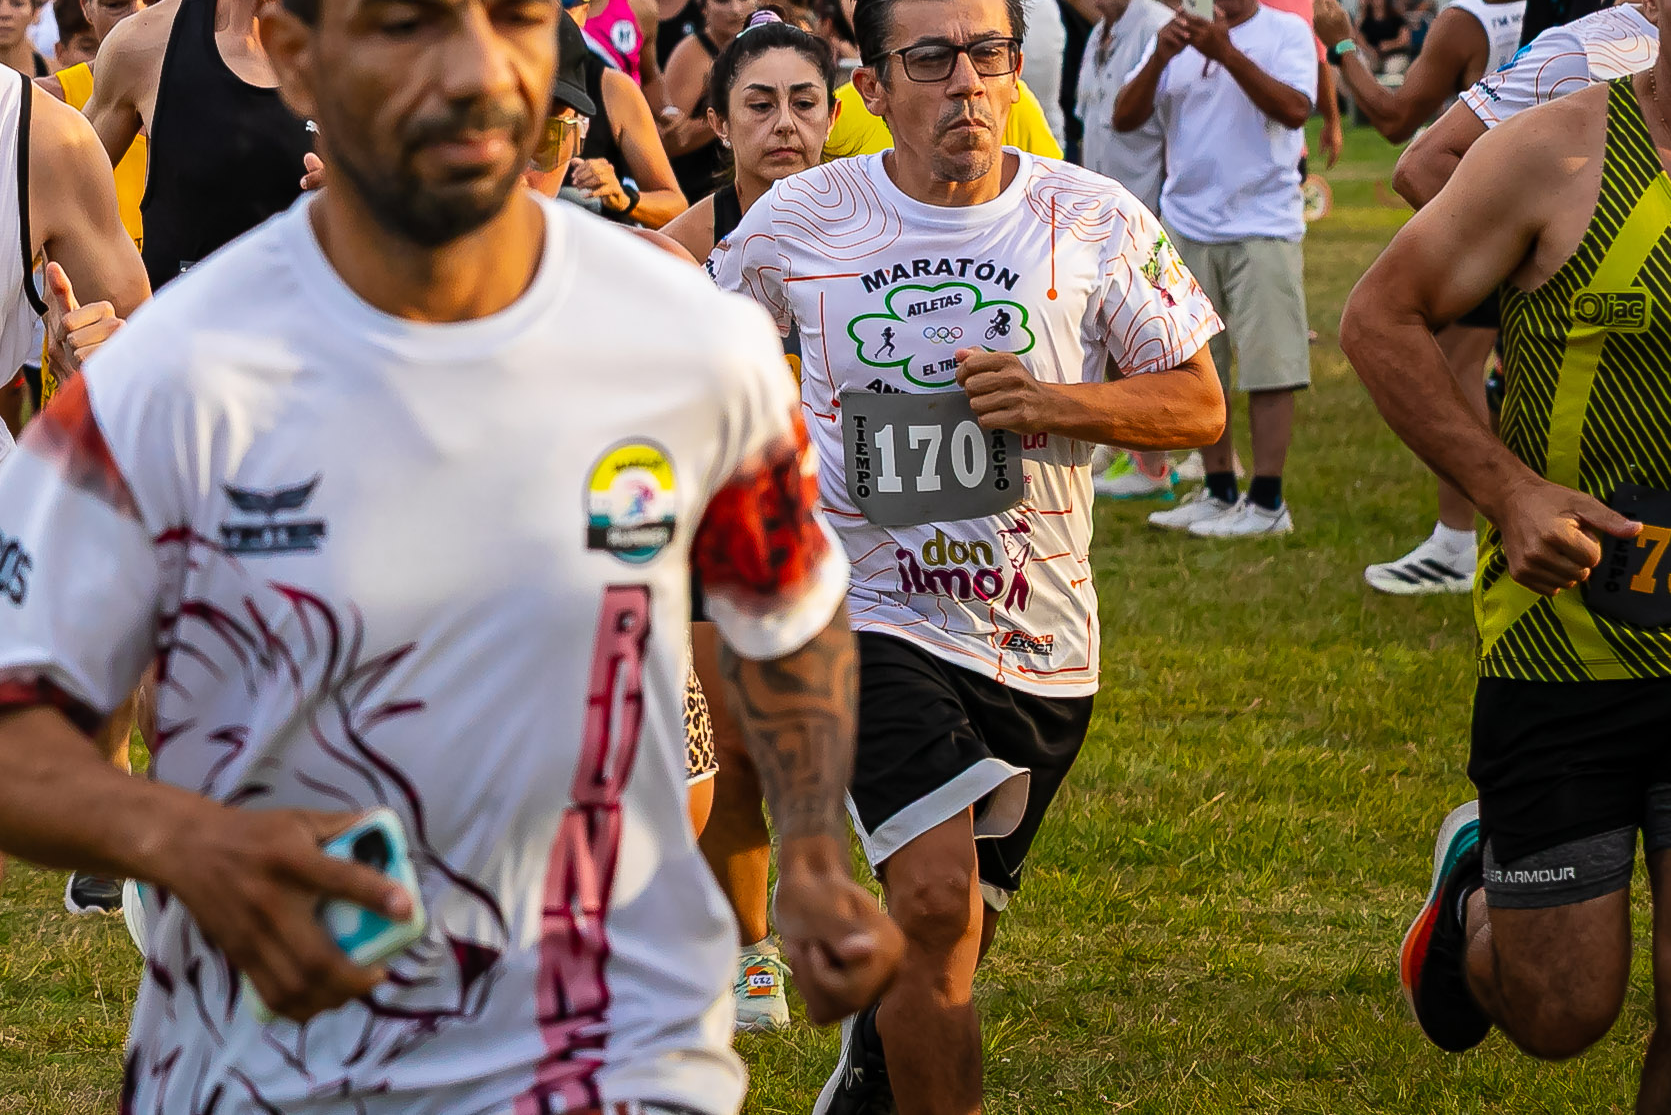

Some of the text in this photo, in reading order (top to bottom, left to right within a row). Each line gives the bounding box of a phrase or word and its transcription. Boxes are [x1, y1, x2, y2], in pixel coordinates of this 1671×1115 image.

[860, 258, 1021, 294] MARATÓN
[907, 293, 963, 317] ATLETAS
[922, 363, 938, 376] EL
[852, 415, 872, 499] TIEMPO
[874, 420, 988, 494] 170
[990, 428, 1010, 491] ACTO
[921, 529, 995, 567] don
[1630, 524, 1671, 593] 7
[1504, 867, 1576, 884] ARMOUR
